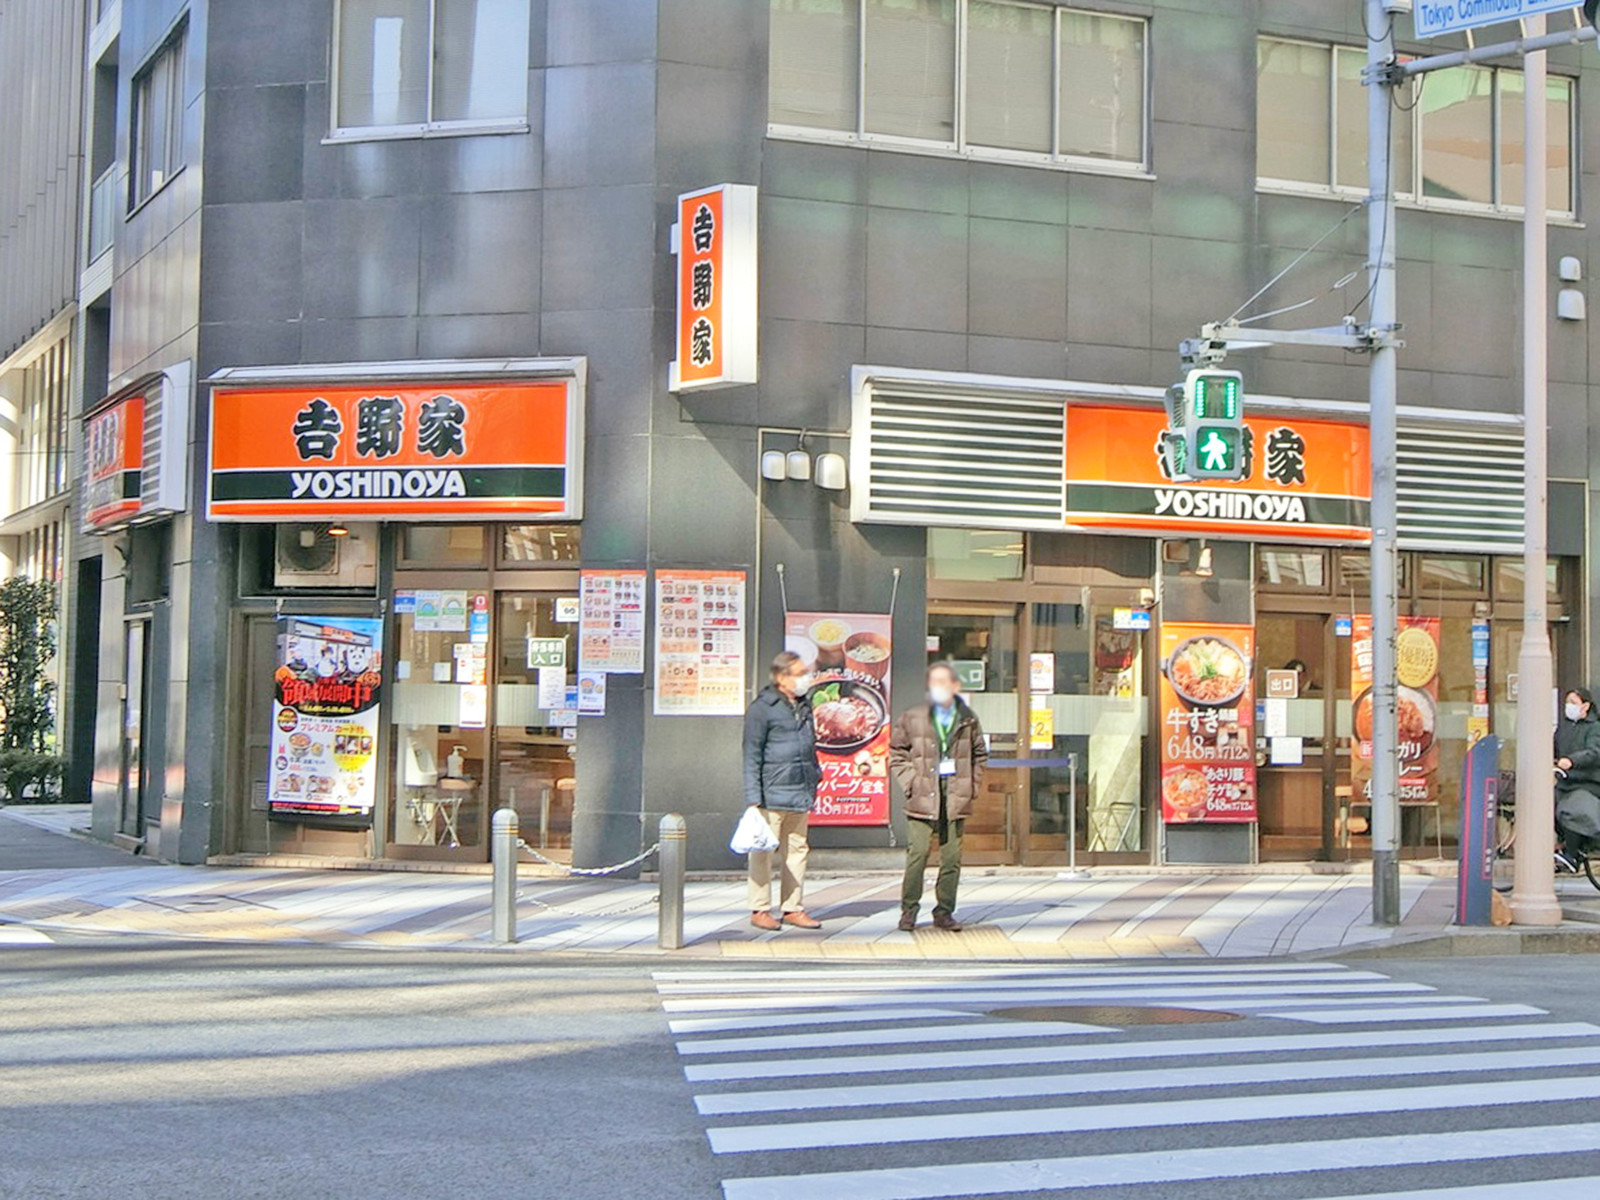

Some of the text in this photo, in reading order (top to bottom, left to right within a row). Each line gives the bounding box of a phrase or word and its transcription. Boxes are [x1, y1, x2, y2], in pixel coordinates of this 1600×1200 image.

[1421, 5, 1454, 27] Tokyo
[292, 470, 466, 499] YOSHINOYA
[1154, 489, 1306, 522] YOSHINOYA
[533, 654, 561, 665] 入口
[1271, 678, 1292, 691] 出口
